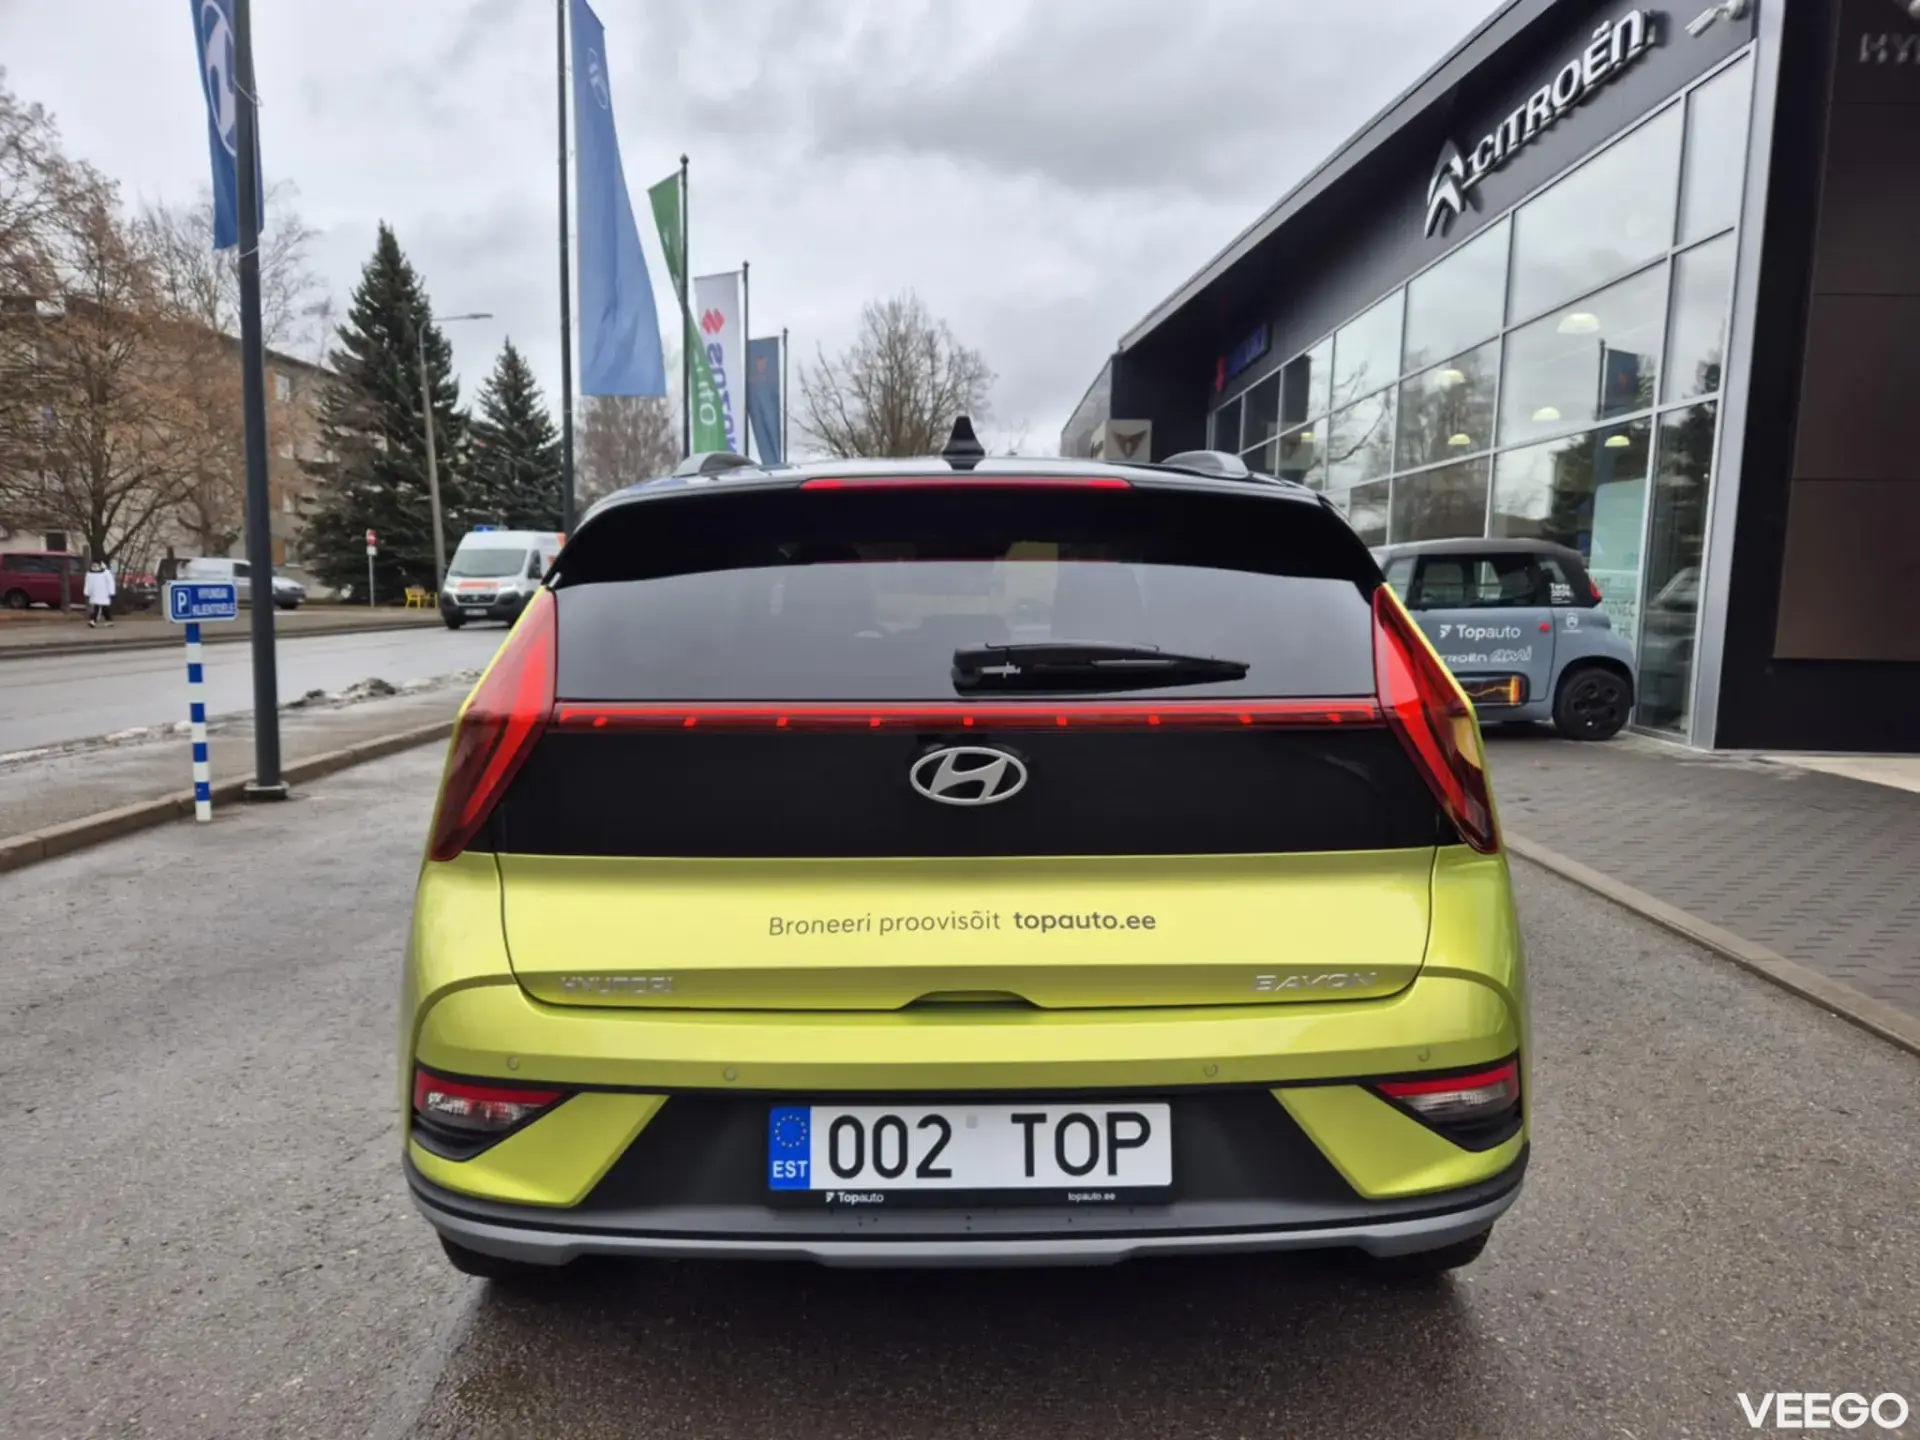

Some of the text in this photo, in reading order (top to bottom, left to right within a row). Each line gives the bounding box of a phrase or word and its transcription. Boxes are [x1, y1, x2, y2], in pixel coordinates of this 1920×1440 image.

[1860, 31, 1920, 63] HY
[1456, 624, 1521, 641] Topauto
[769, 910, 1156, 936] Broneeri proovisõit topauto.ee
[828, 1112, 1151, 1179] 002 TOP
[772, 1160, 808, 1178] EST
[838, 1191, 884, 1204] Topauto
[1067, 1191, 1116, 1202] topauto.ee
